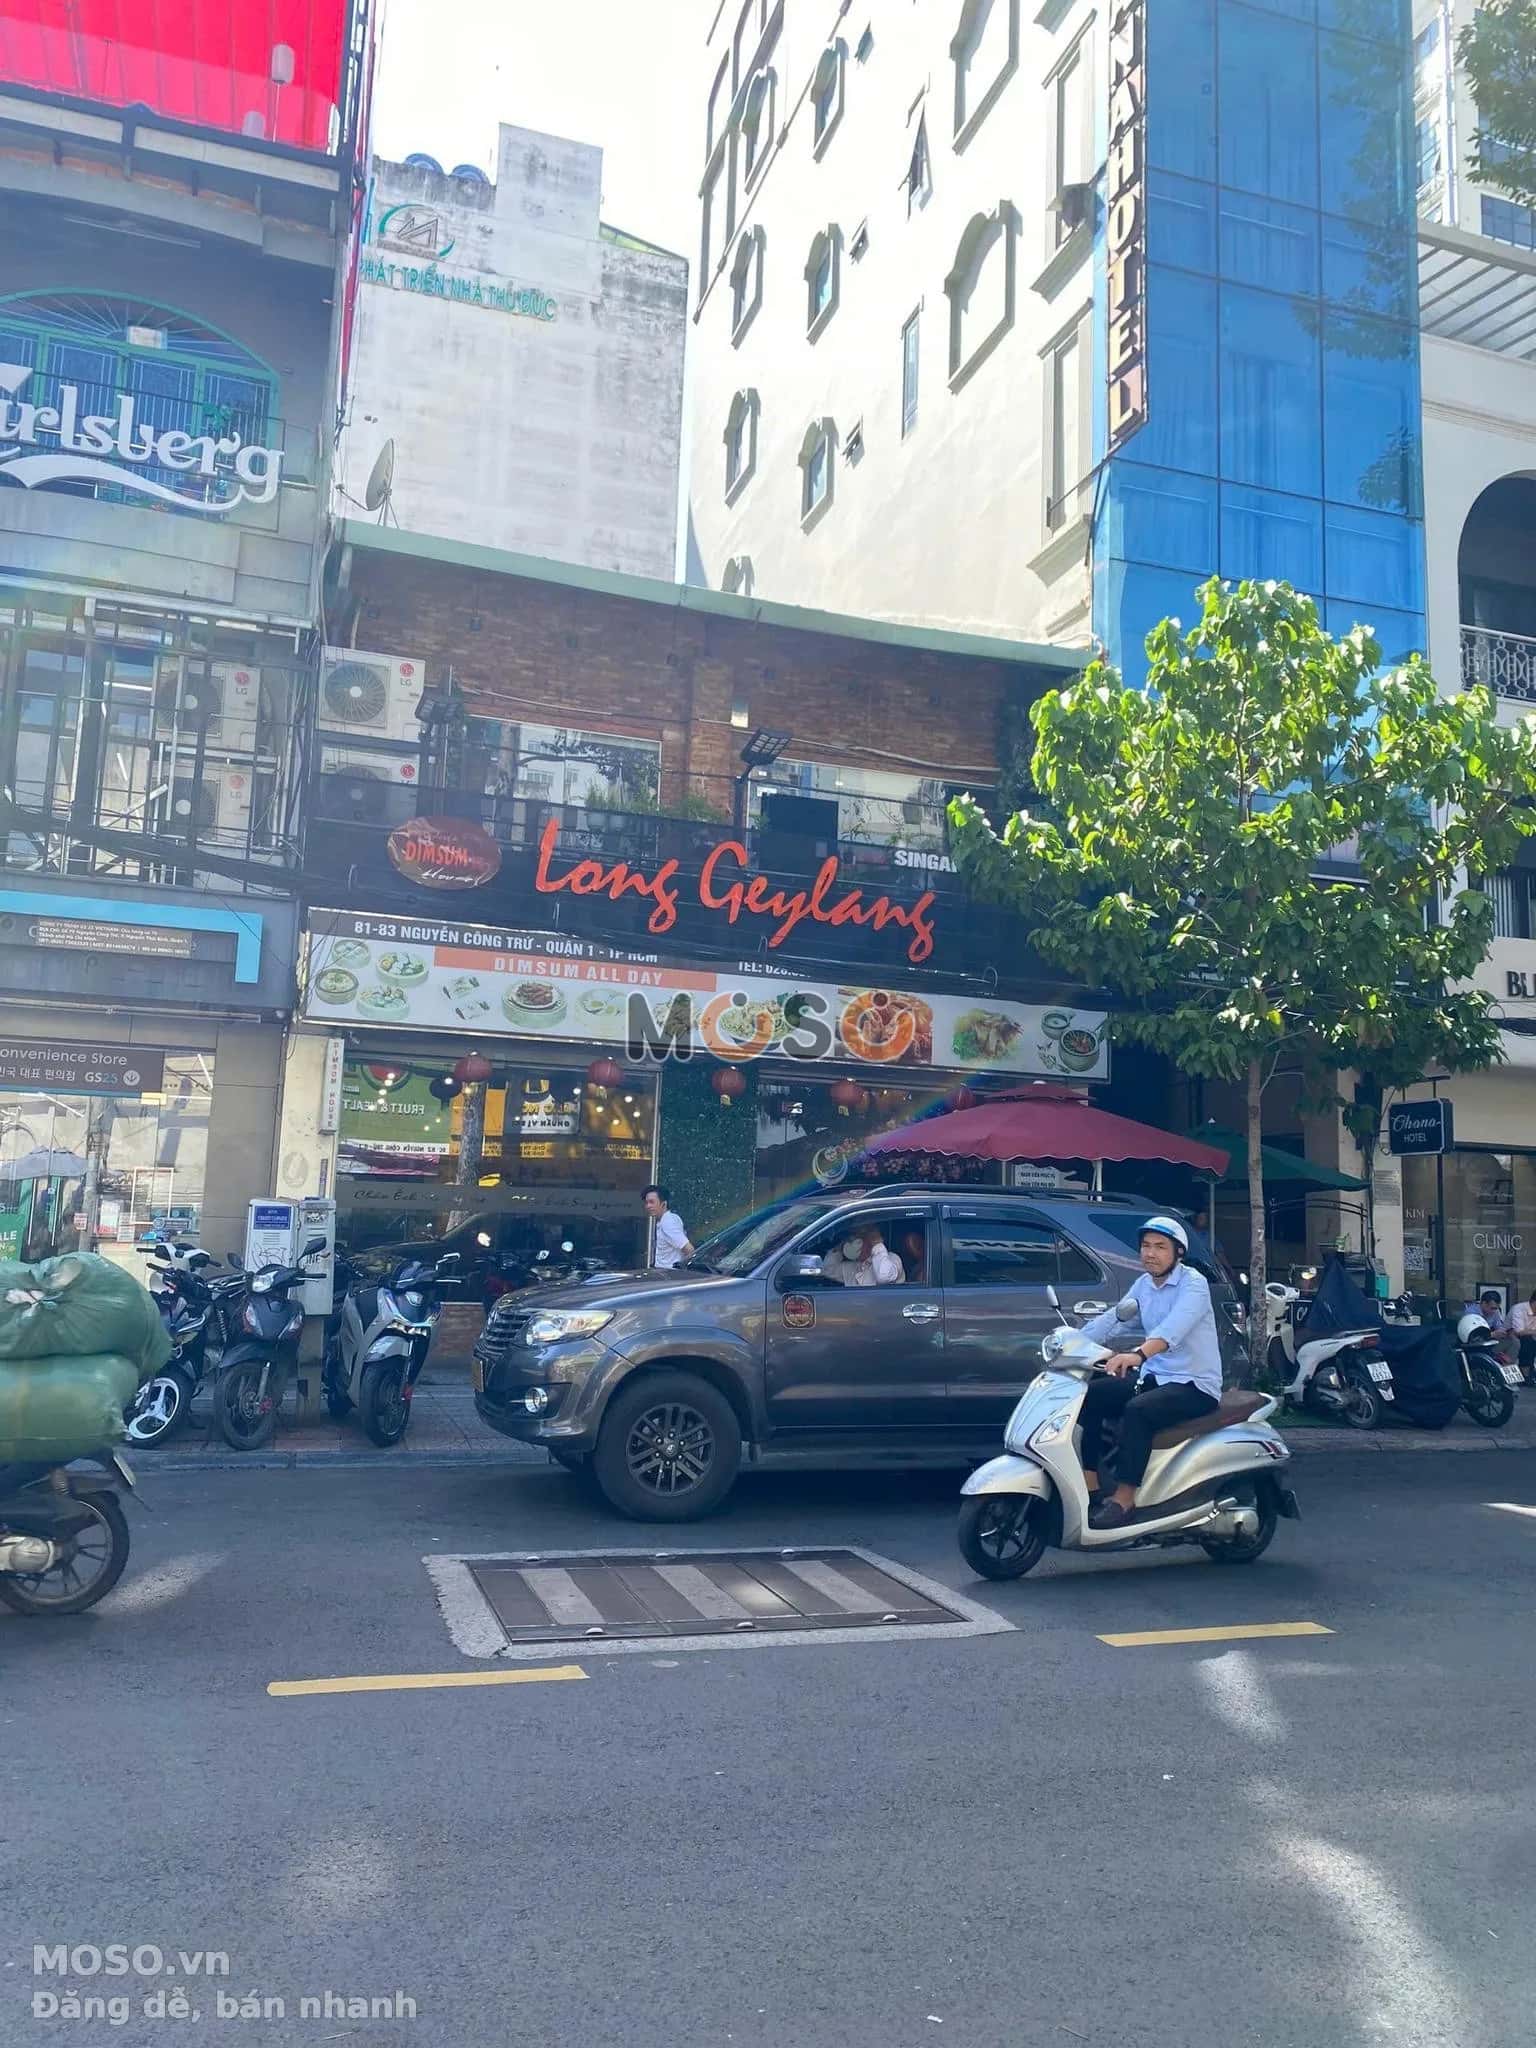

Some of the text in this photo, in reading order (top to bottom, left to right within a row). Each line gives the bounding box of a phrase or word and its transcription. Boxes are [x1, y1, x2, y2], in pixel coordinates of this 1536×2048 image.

[535, 817, 938, 963] Long Geylang
[354, 921, 397, 938] 81-83
[400, 922, 460, 944] NGUYỄN
[463, 930, 502, 948] CÔNG
[506, 934, 533, 951] TRỨ
[546, 940, 584, 957] QUẬN
[587, 944, 594, 956] 1
[494, 956, 663, 986] DIMSUM ALL DAY
[1507, 970, 1536, 999] BL
[91, 1052, 128, 1066] Store
[84, 1071, 119, 1084] GS25
[1403, 1132, 1428, 1142] HOTEL
[1472, 1232, 1523, 1251] CLINIC
